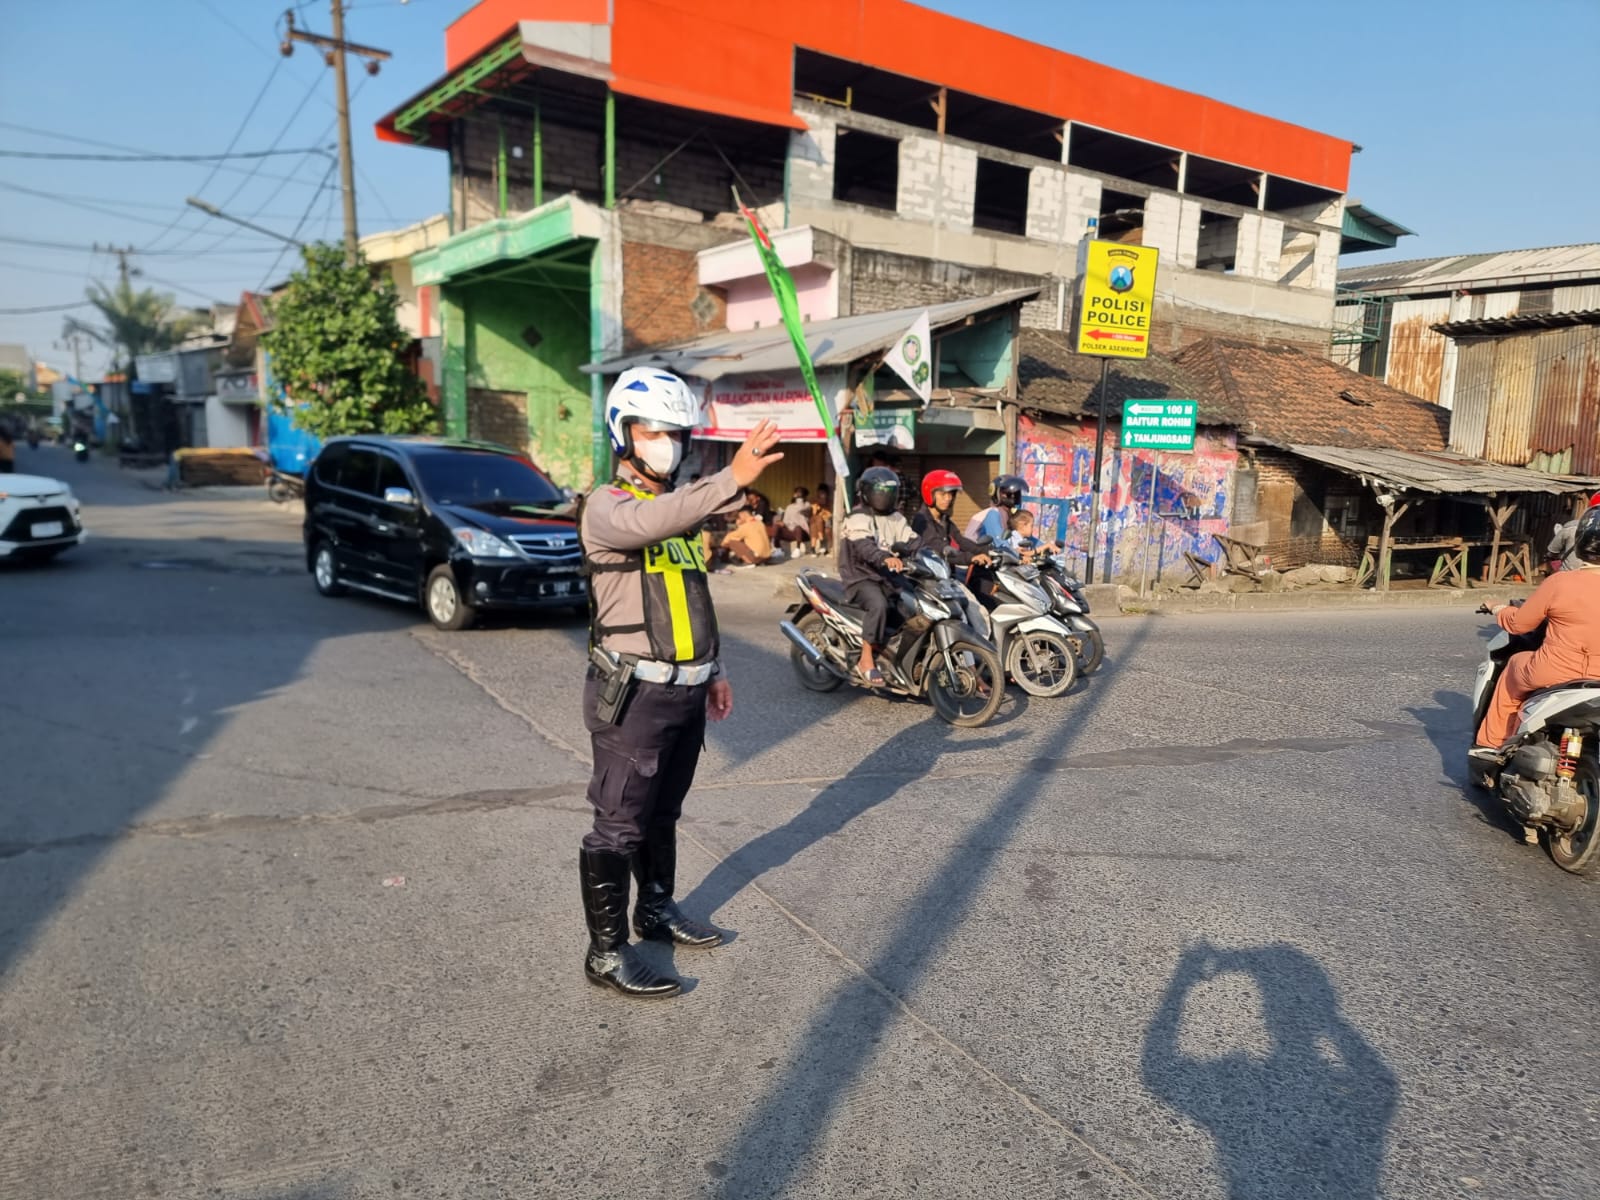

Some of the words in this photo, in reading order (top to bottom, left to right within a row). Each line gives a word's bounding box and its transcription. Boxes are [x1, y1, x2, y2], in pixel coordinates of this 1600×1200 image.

[1091, 297, 1145, 312] POLISI
[1087, 311, 1147, 327] POLICE
[1082, 342, 1106, 350] POLSEK
[1166, 404, 1183, 415] 100
[1184, 404, 1193, 415] M
[1126, 416, 1159, 427] BAITUR
[1161, 417, 1192, 427] ROHIM
[1133, 433, 1192, 445] TANJUNGSARI
